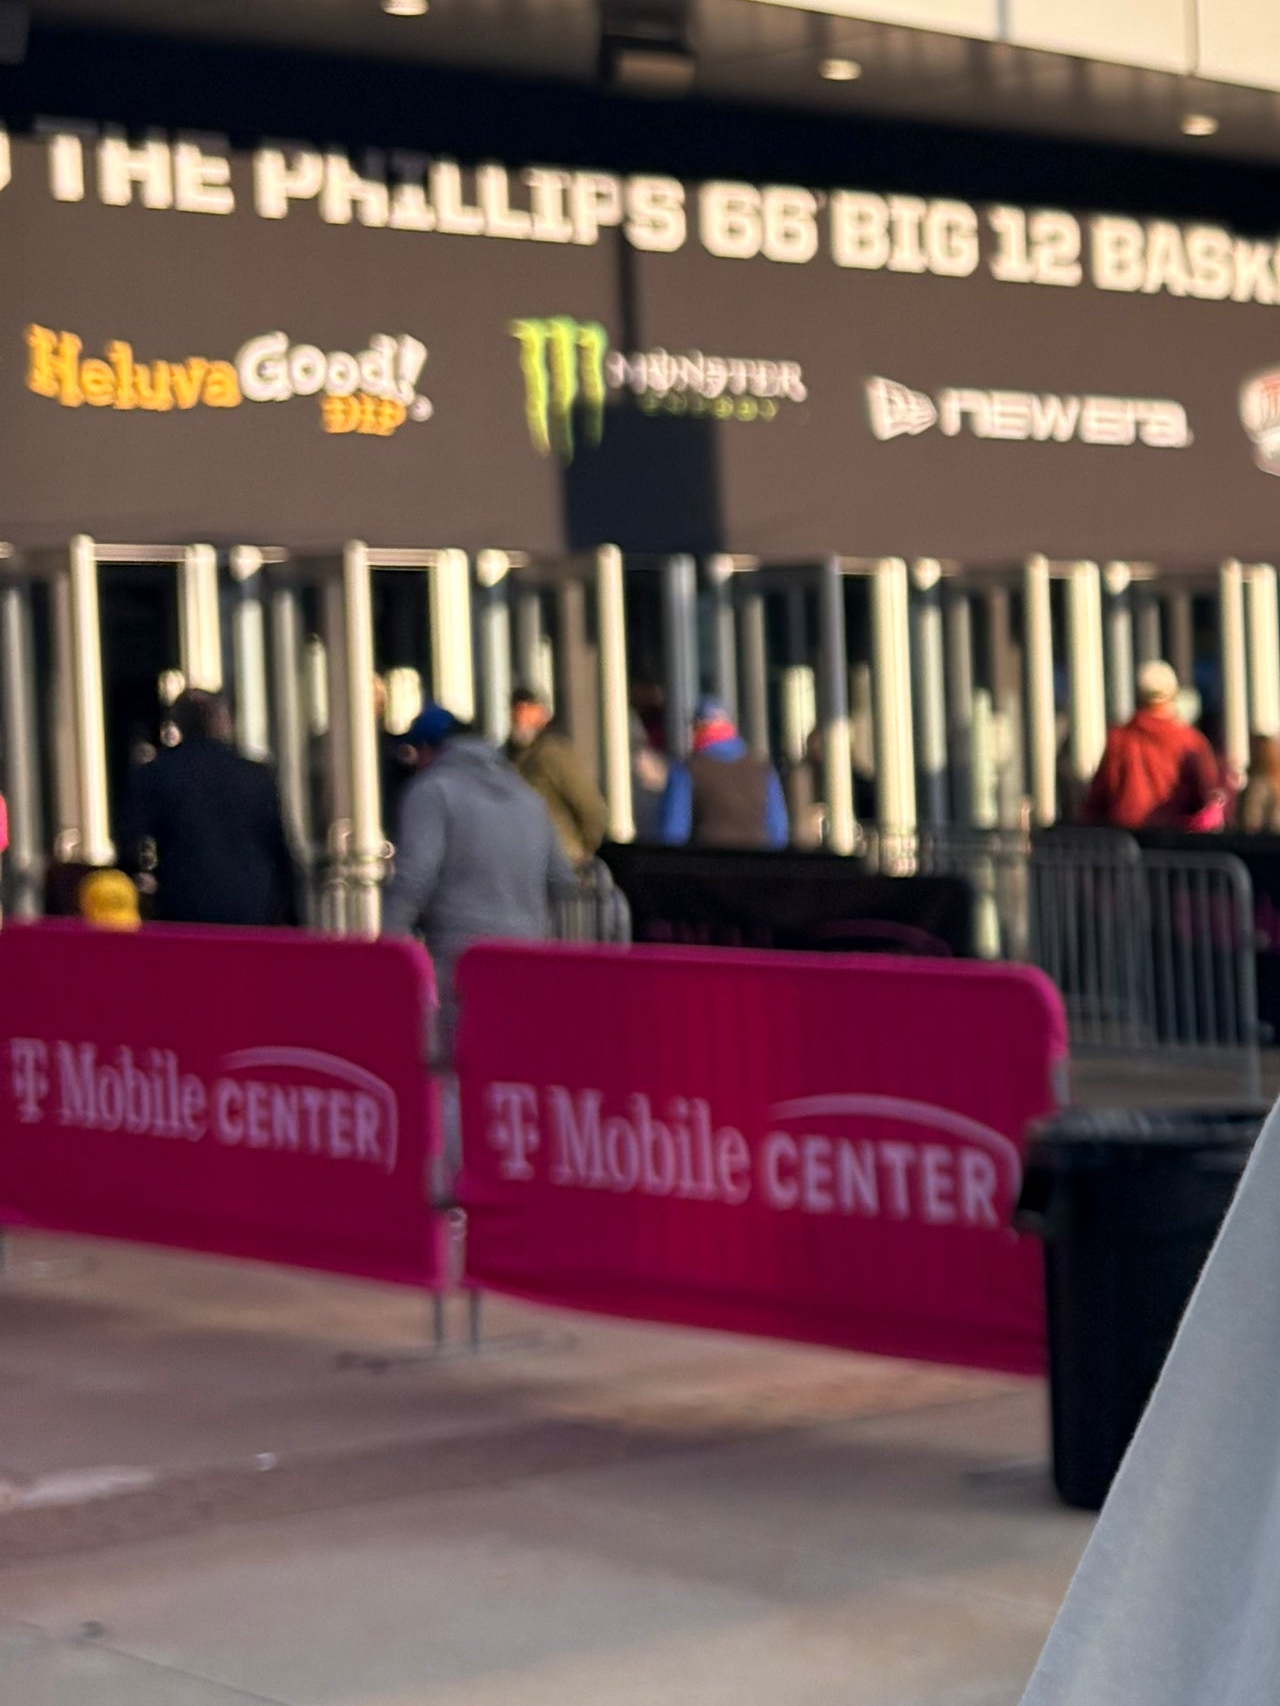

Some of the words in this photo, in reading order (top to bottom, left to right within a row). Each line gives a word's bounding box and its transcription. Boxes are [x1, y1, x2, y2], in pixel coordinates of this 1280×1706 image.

[36, 115, 235, 216] THE
[254, 138, 687, 254] PHILLIPS
[699, 179, 820, 265] 66
[830, 190, 980, 278] BIG
[987, 203, 1083, 288] 12
[56, 1039, 207, 1142] Mobile
[215, 1076, 382, 1161] CENTER
[549, 1083, 752, 1205] Mobile
[763, 1130, 999, 1227] CENTER
